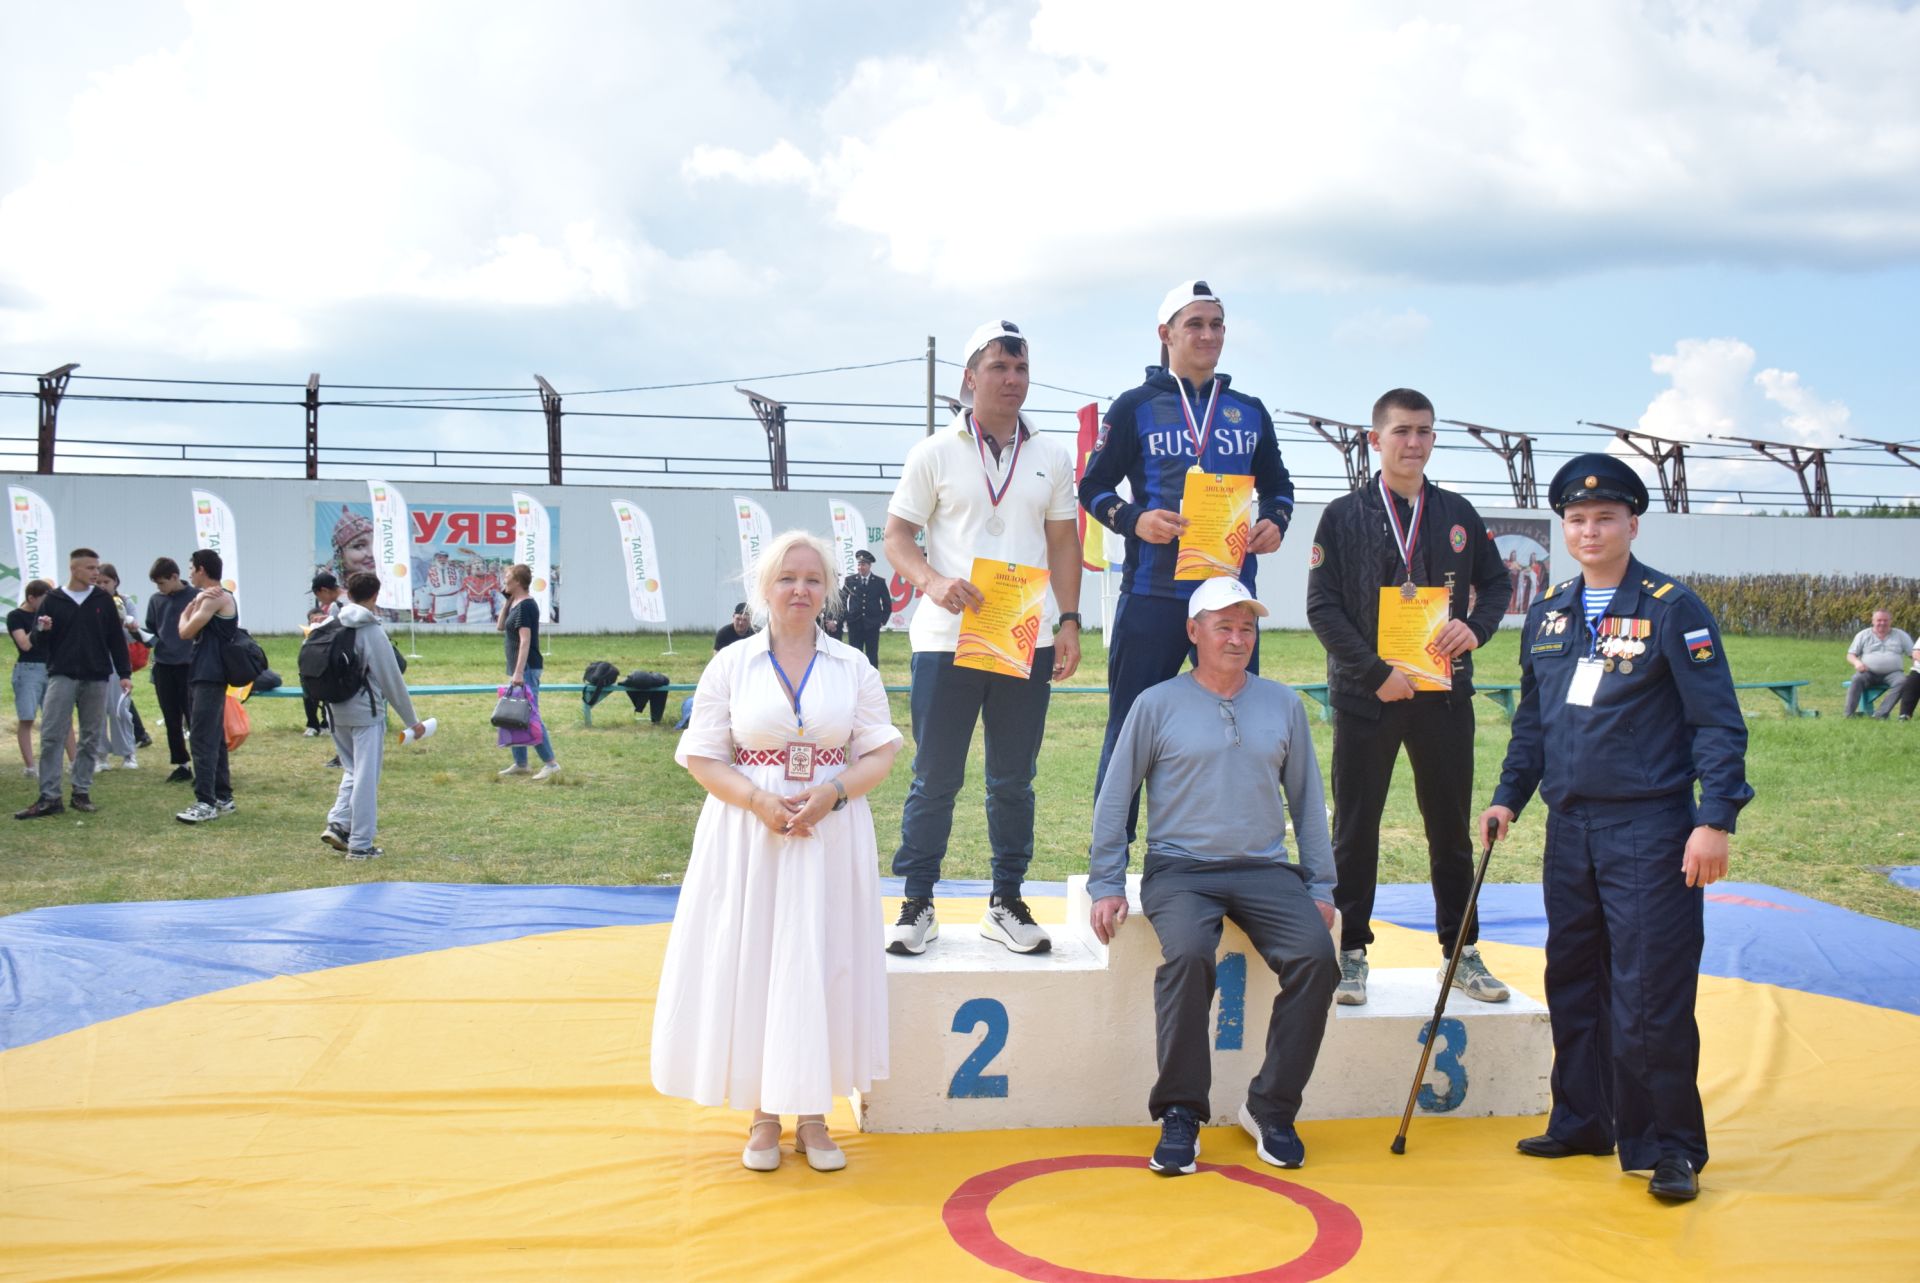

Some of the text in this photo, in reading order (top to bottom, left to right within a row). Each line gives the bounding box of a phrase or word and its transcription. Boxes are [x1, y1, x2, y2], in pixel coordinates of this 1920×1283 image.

[412, 511, 517, 545] УЯВ
[947, 997, 1009, 1099] 2
[1215, 952, 1247, 1050] 1
[1417, 1018, 1468, 1113] 3
